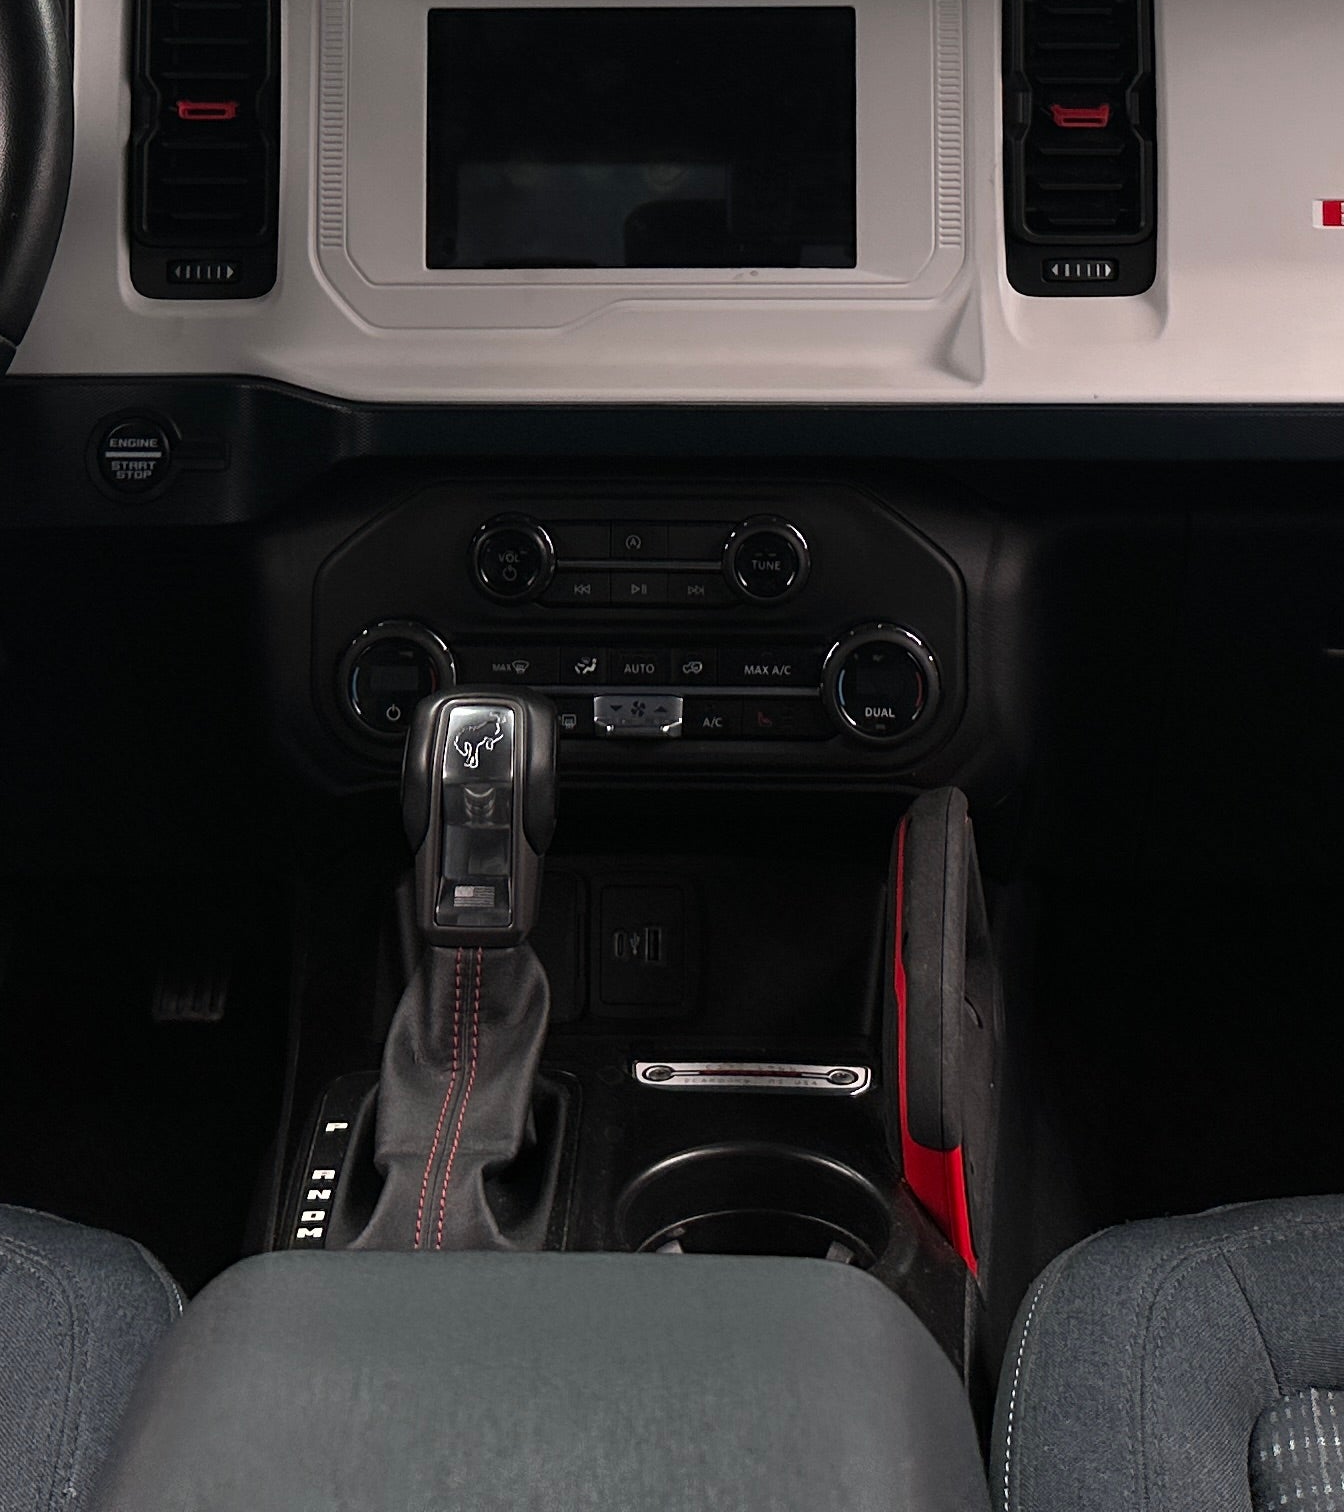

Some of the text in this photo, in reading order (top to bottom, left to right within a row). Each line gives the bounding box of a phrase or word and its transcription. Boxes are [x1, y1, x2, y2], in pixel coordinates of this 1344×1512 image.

[109, 438, 159, 448] ENGINE
[111, 461, 156, 471] START
[116, 471, 152, 480] STOP
[498, 552, 520, 564] VOL
[752, 560, 781, 571] TUNE
[492, 662, 511, 672] MAX
[623, 663, 655, 674] AUTO
[744, 664, 792, 676] MAX A/C
[864, 706, 895, 718] DUAL
[702, 717, 723, 728] A/C
[325, 1122, 348, 1132] P
[307, 1190, 332, 1200] N
[297, 1227, 323, 1238] M
